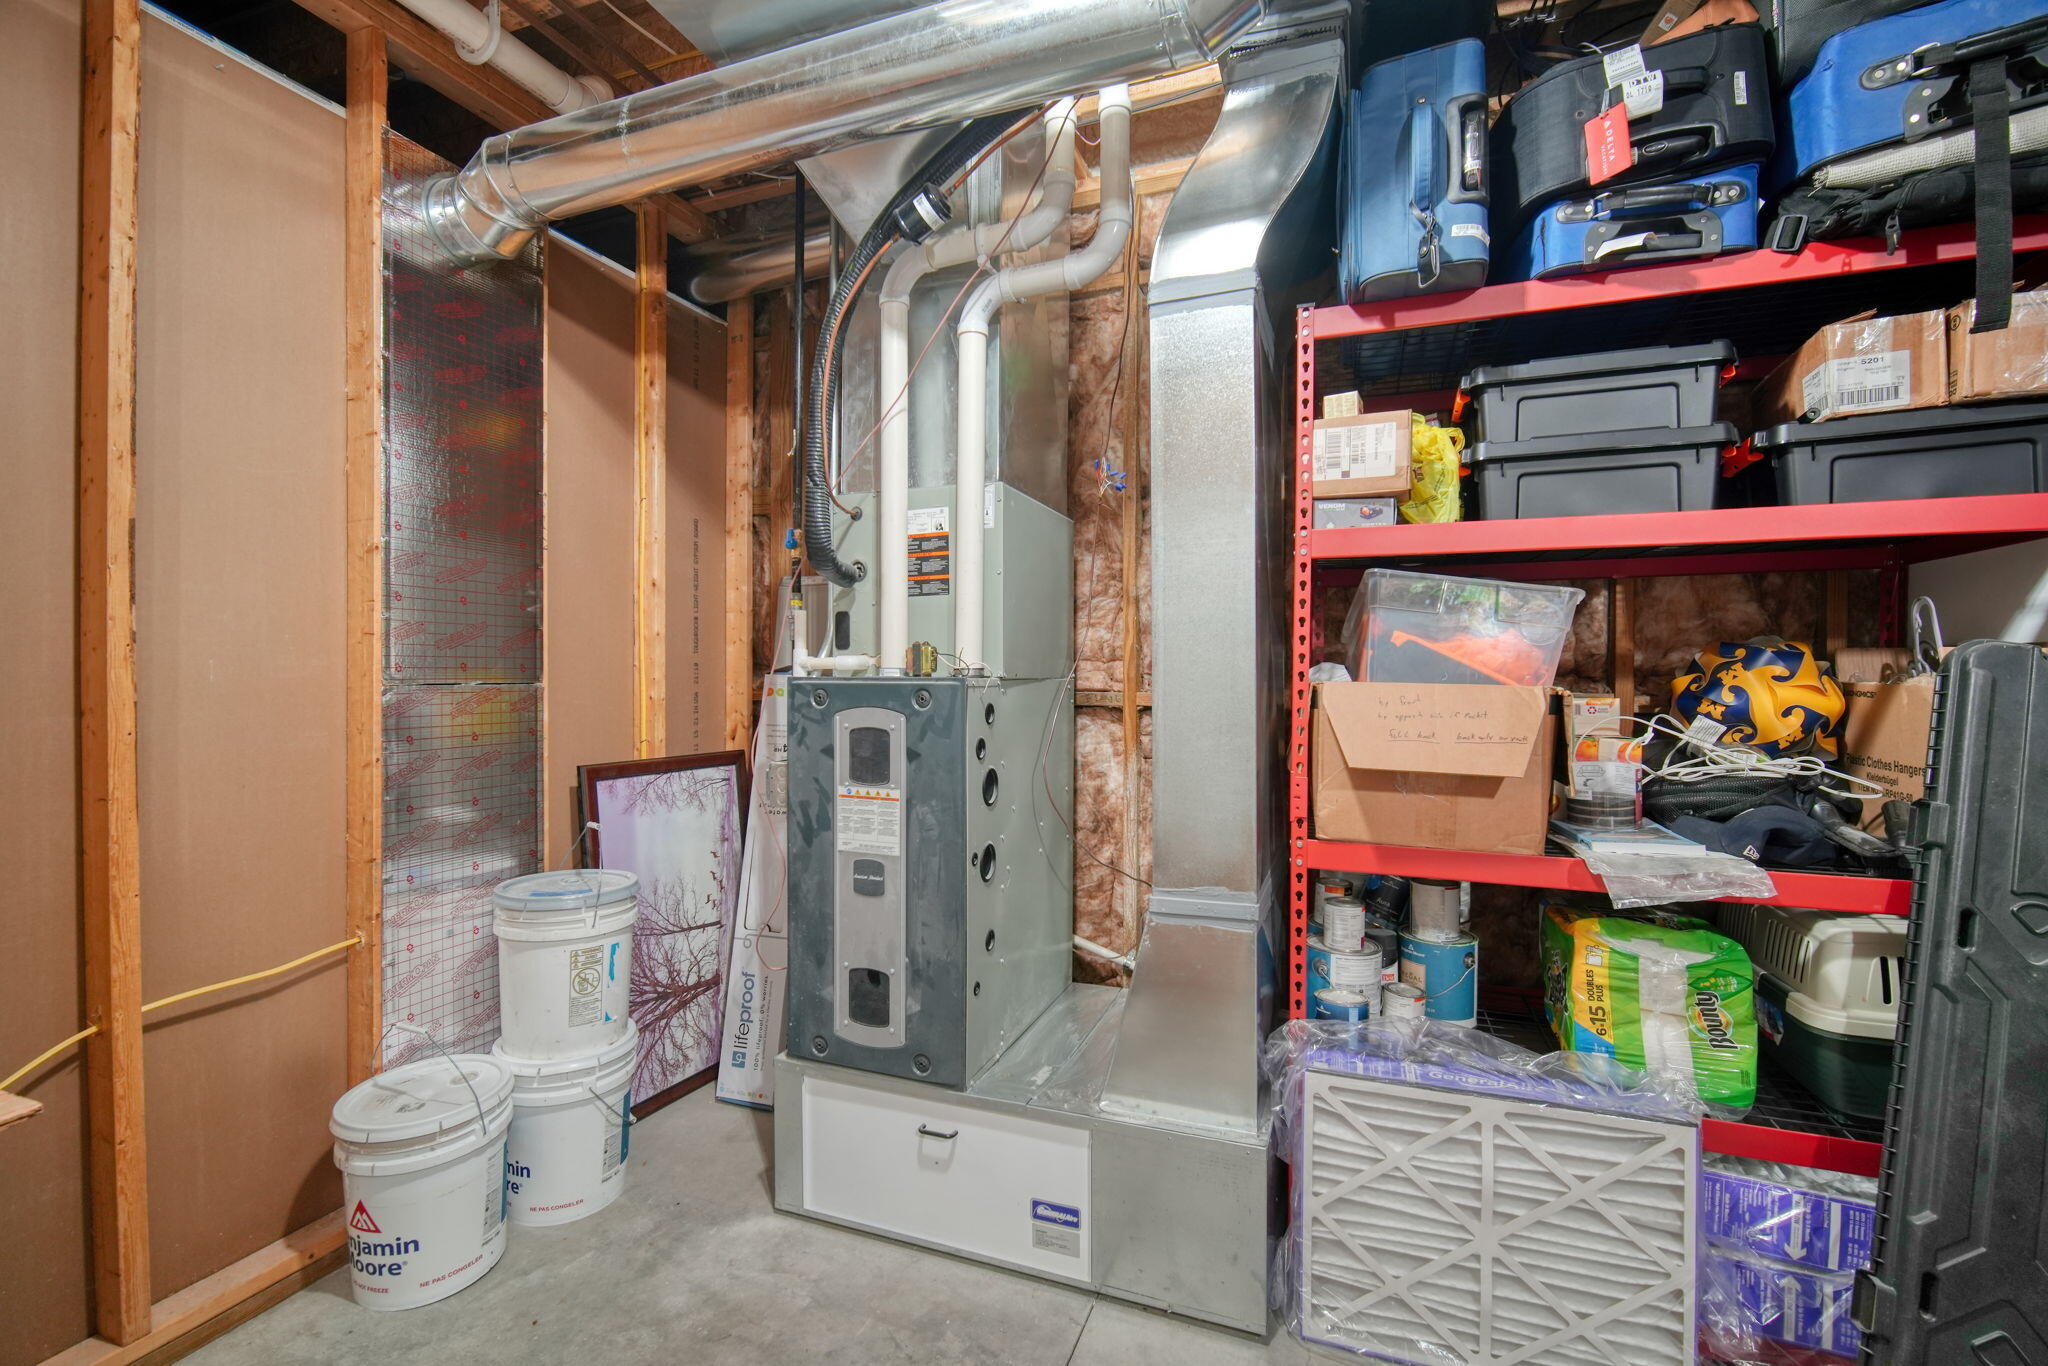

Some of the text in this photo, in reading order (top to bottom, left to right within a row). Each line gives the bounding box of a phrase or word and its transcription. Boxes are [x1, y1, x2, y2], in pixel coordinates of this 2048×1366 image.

[1605, 128, 1616, 162] DELTA
[1861, 357, 1884, 365] 5201
[1866, 755, 1893, 773] Clothes
[1893, 760, 1926, 778] Hangers
[1587, 969, 1595, 1001] DOUBLES
[1596, 984, 1605, 1002] PLUS
[734, 971, 755, 1049] lifeproof
[1695, 991, 1740, 1050] Bounty
[551, 1199, 584, 1211] CONGELER
[350, 1235, 419, 1257] njamin
[432, 1275, 446, 1285] PAS
[447, 1254, 484, 1278] CONGELER
[367, 1285, 389, 1294] FREEZE
